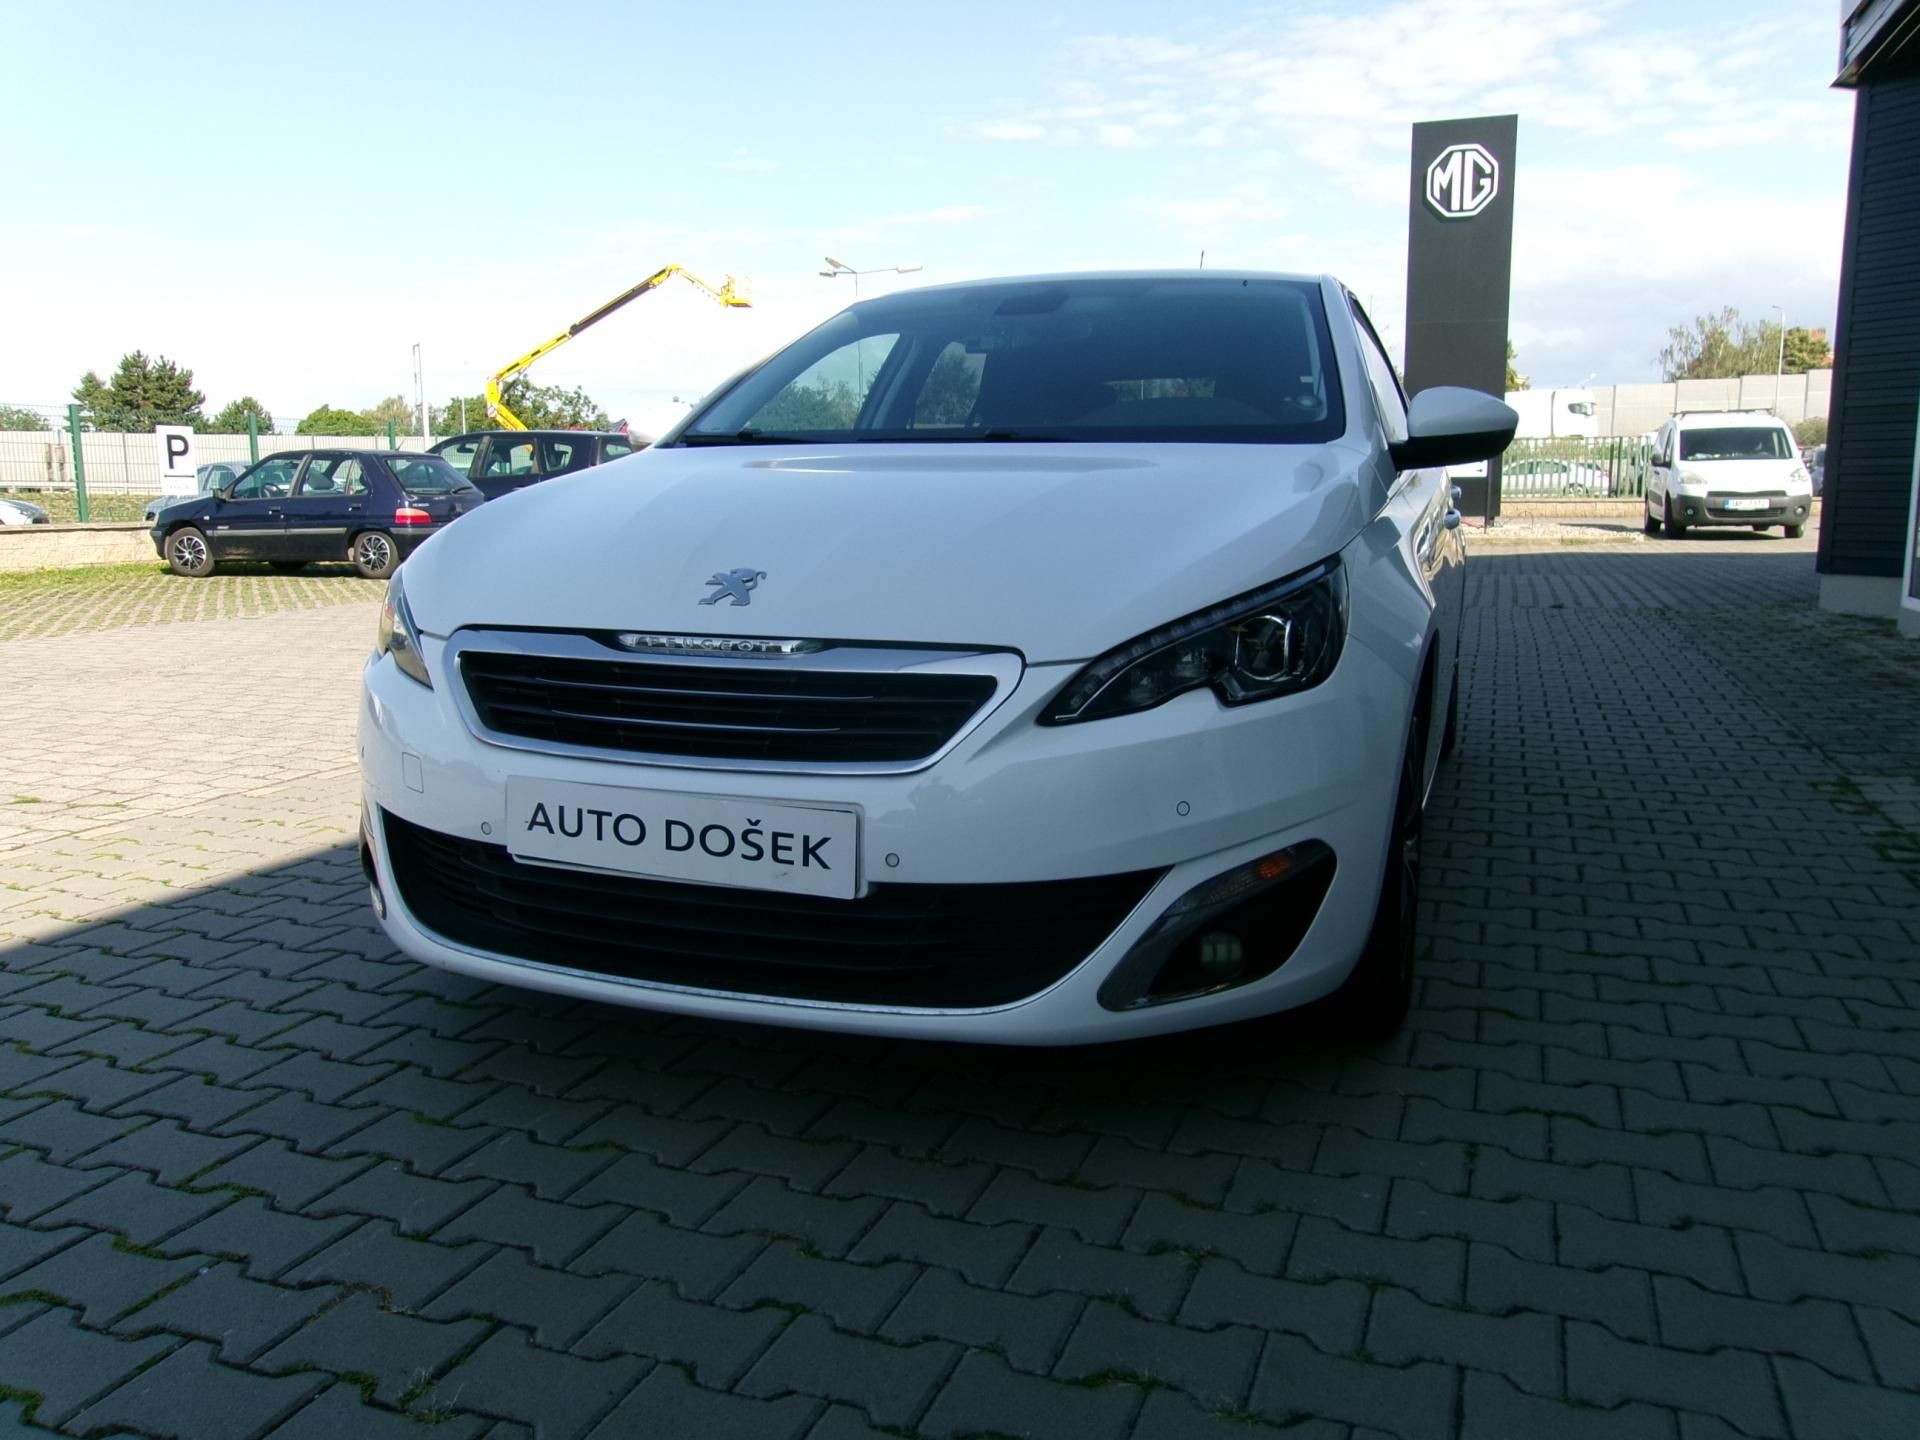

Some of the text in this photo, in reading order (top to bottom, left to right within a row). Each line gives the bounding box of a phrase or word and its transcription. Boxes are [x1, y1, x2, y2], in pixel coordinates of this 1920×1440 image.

[1432, 150, 1492, 212] MG
[166, 434, 189, 469] P
[647, 635, 771, 653] PEUGEOT
[527, 802, 832, 870] AUTO DOŠEK
